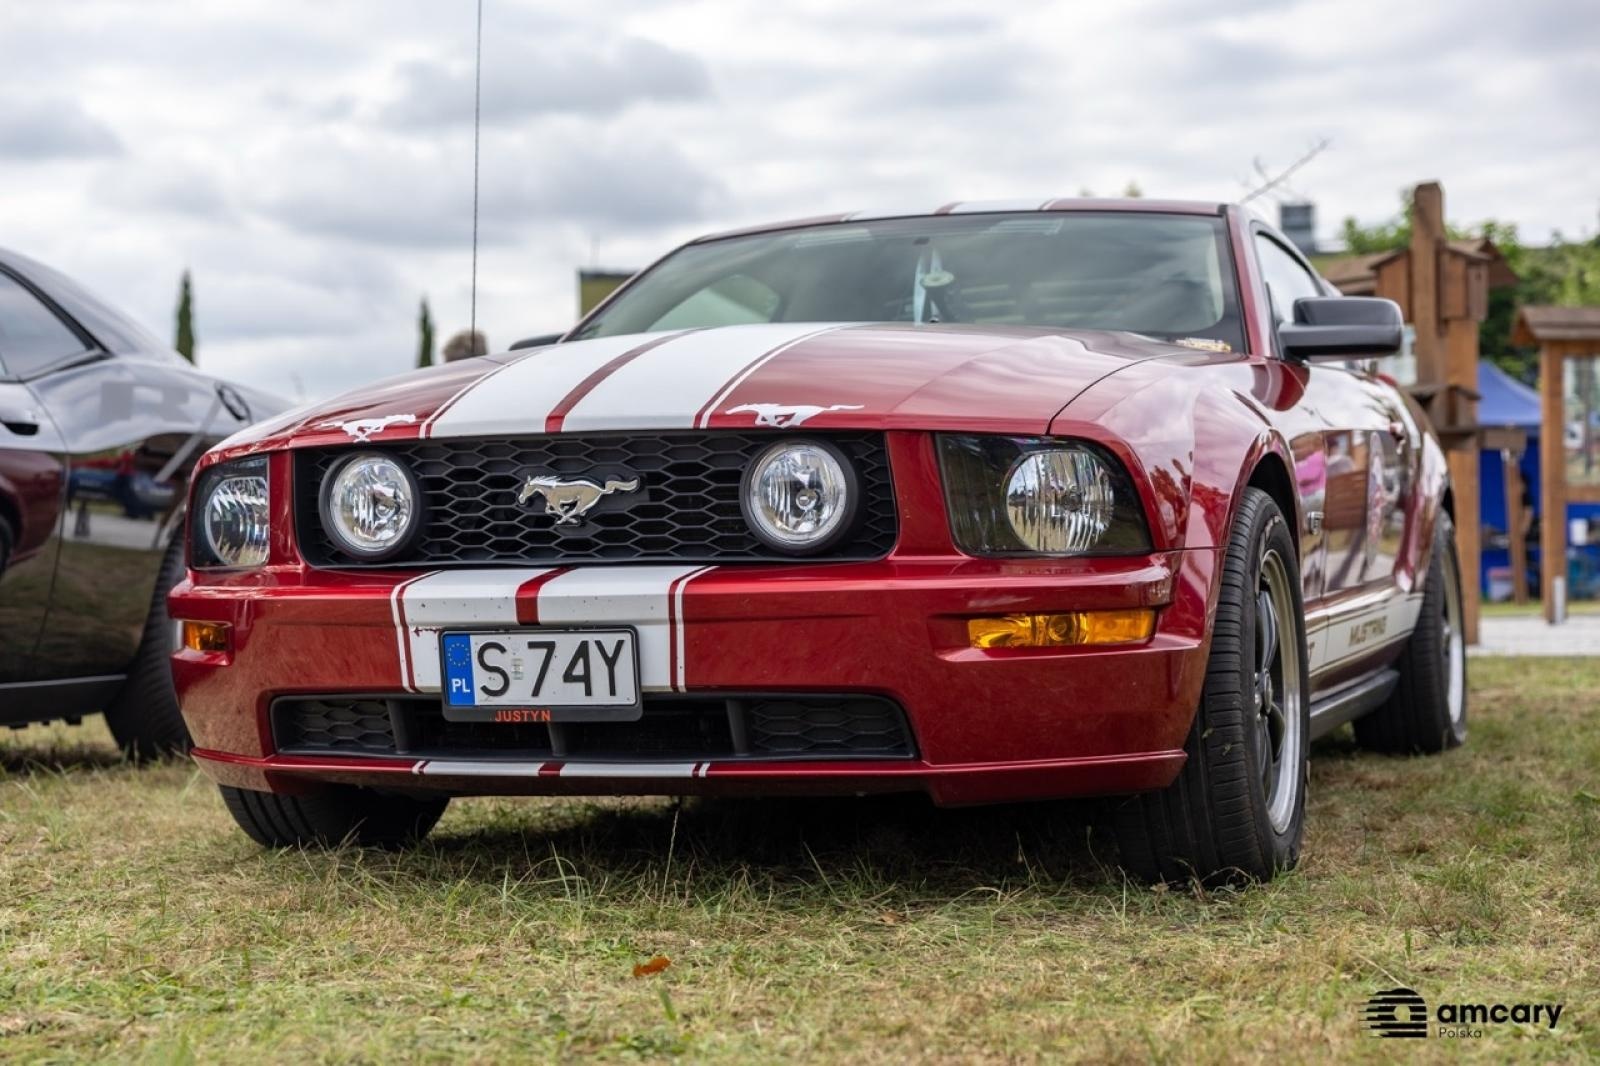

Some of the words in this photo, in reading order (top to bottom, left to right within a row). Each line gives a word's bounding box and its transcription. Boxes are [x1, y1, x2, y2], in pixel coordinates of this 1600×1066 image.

[477, 641, 510, 697] S
[527, 639, 625, 697] 74Y
[451, 678, 471, 693] PL
[494, 710, 551, 722] JUSTYN
